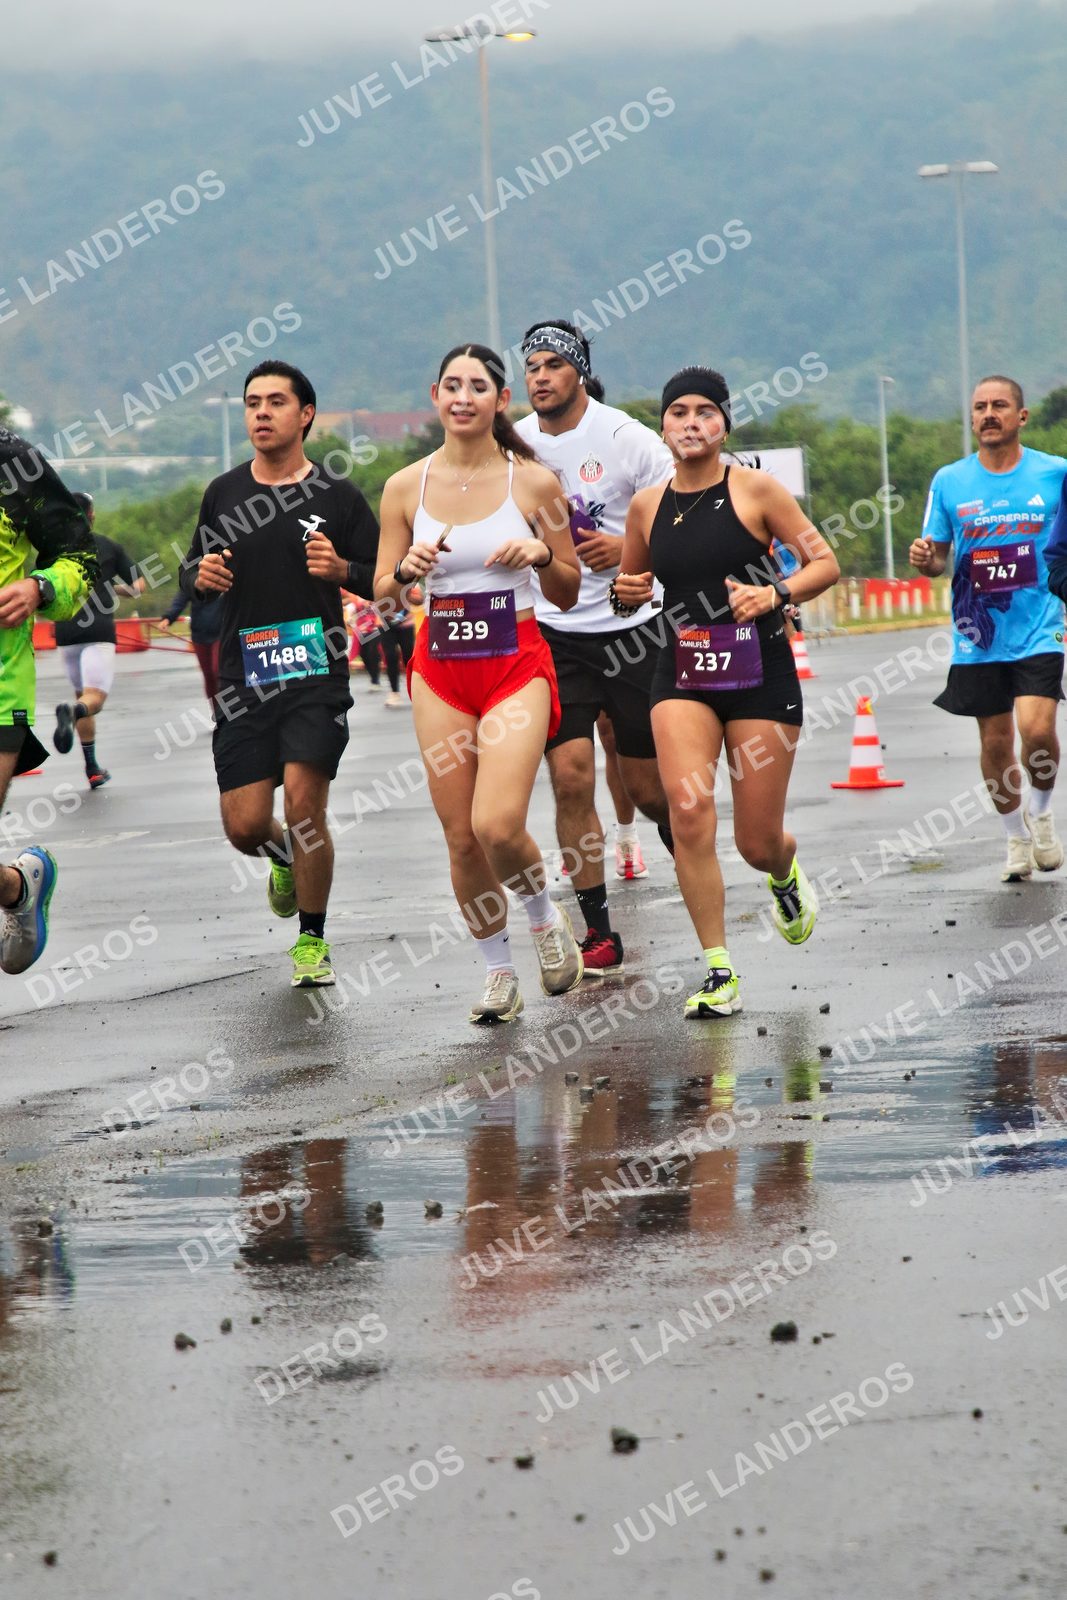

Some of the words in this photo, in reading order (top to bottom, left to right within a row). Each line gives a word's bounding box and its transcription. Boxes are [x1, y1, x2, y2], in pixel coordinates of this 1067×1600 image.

[974, 513, 1030, 526] CARRERA
[1031, 513, 1045, 522] DE
[987, 564, 1017, 580] 747
[246, 629, 279, 643] CARRERA
[301, 623, 316, 636] 10K
[448, 620, 489, 641] 239
[680, 640, 703, 648] OMNILIFE
[258, 645, 307, 668] 1488
[694, 652, 731, 671] 237
